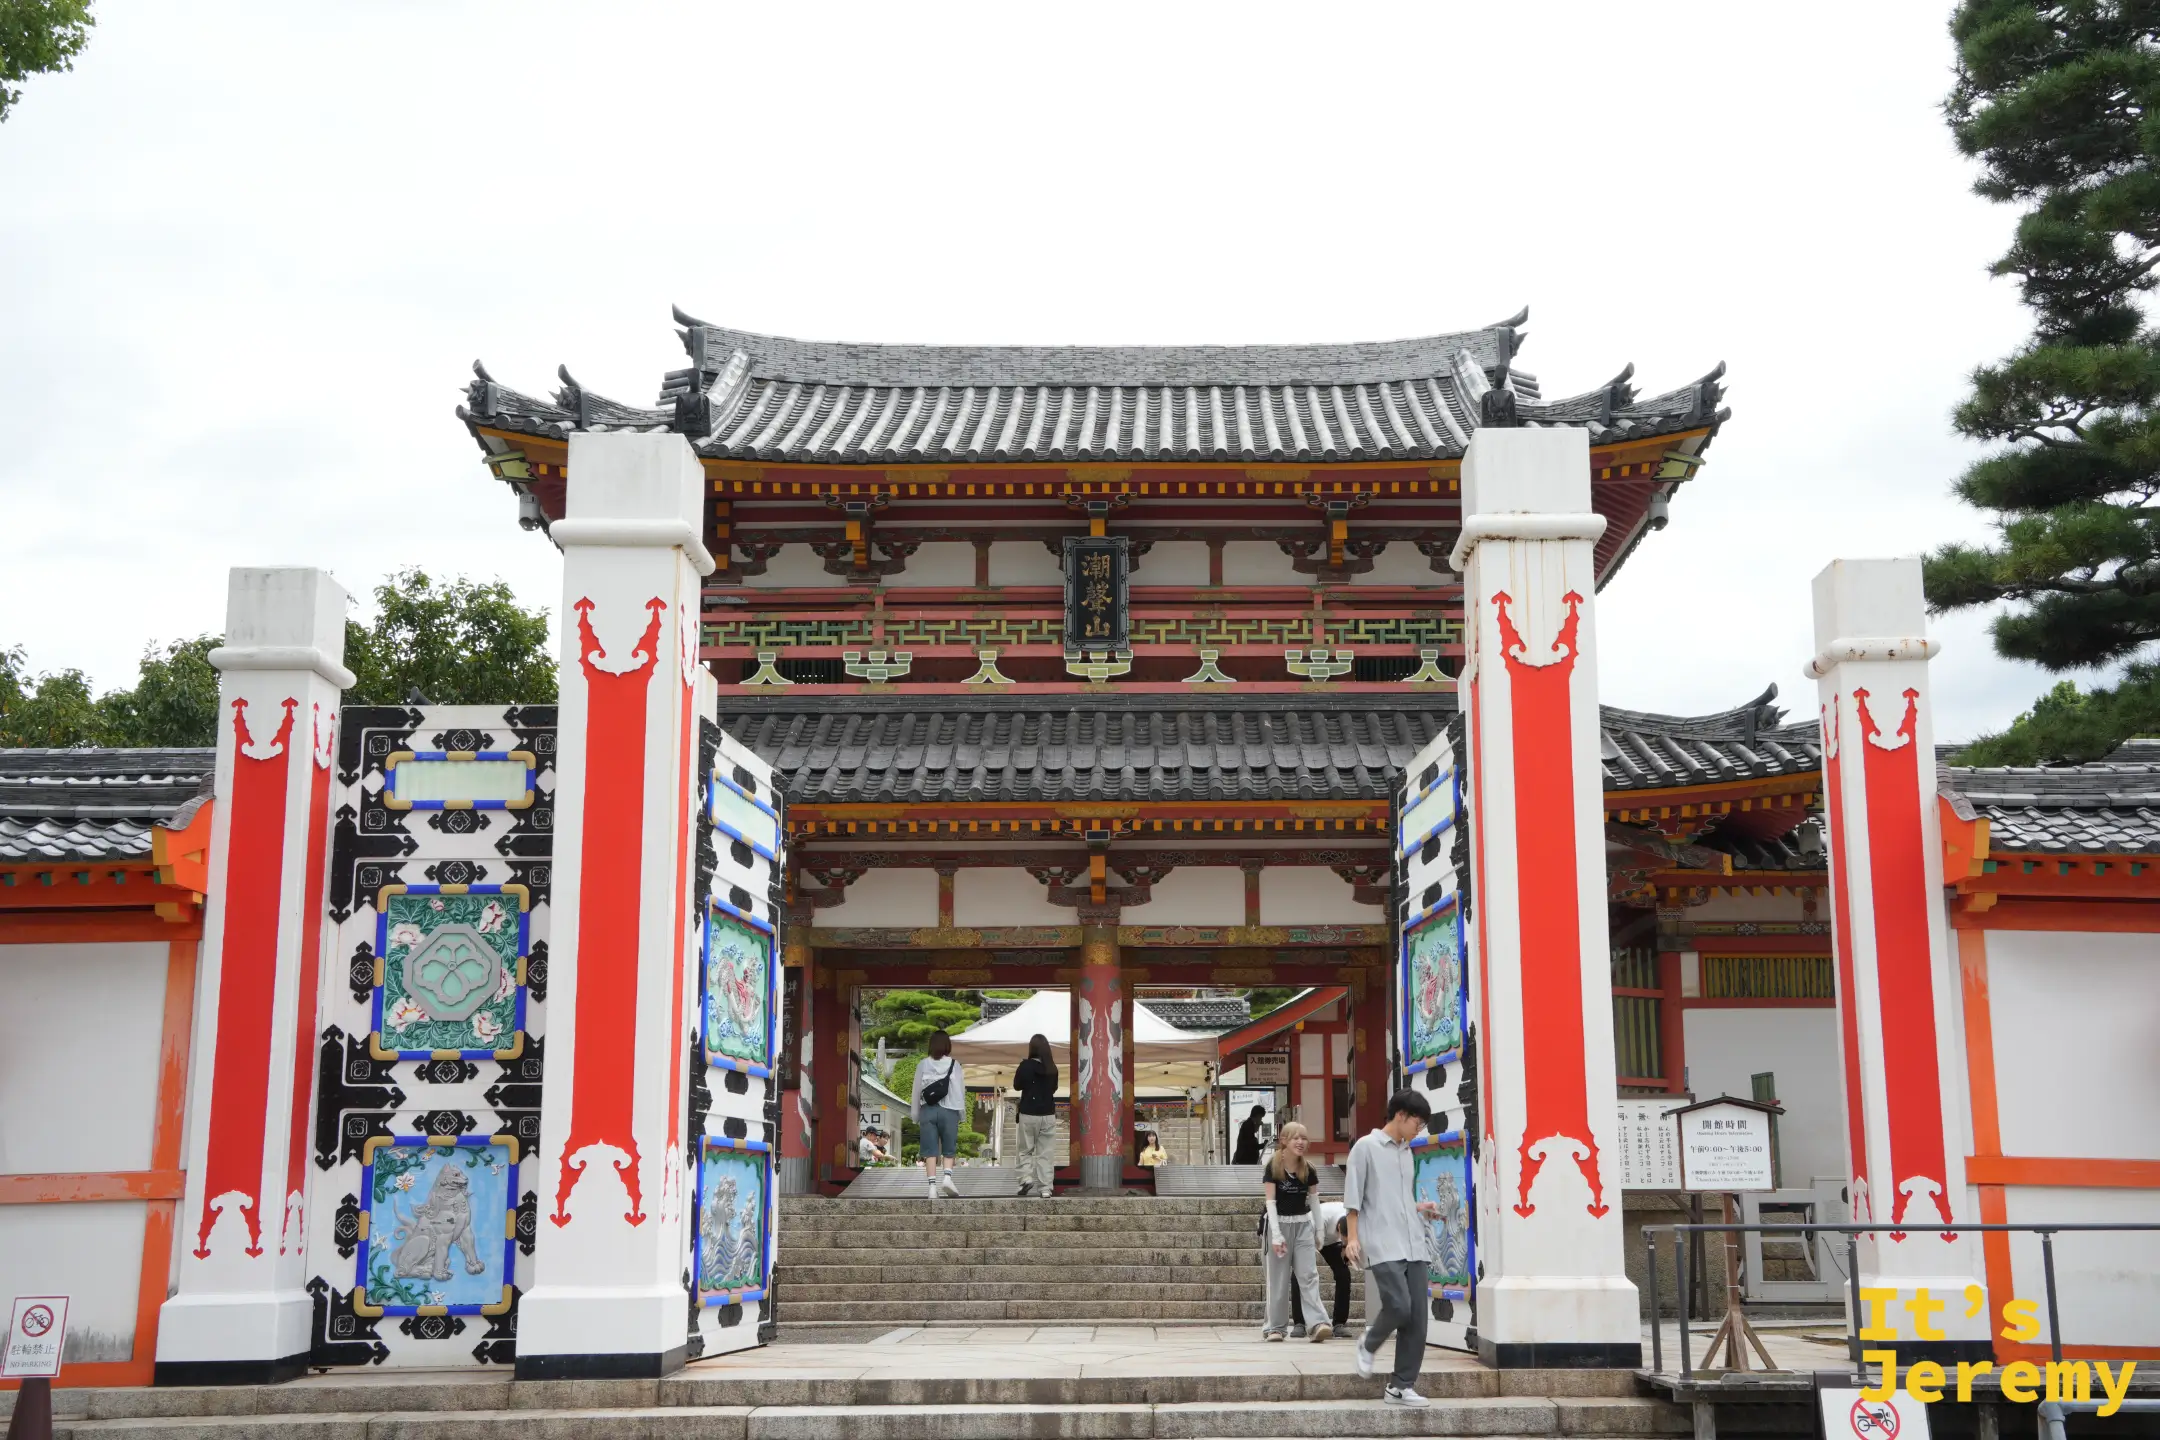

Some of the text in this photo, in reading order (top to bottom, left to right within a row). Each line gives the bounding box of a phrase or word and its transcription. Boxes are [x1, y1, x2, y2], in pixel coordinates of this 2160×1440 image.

[860, 1113, 881, 1124] 入口
[1702, 1119, 1747, 1130] 開館時間
[11, 1344, 56, 1356] 駐輪禁止
[10, 1360, 52, 1369] NO PARKING
